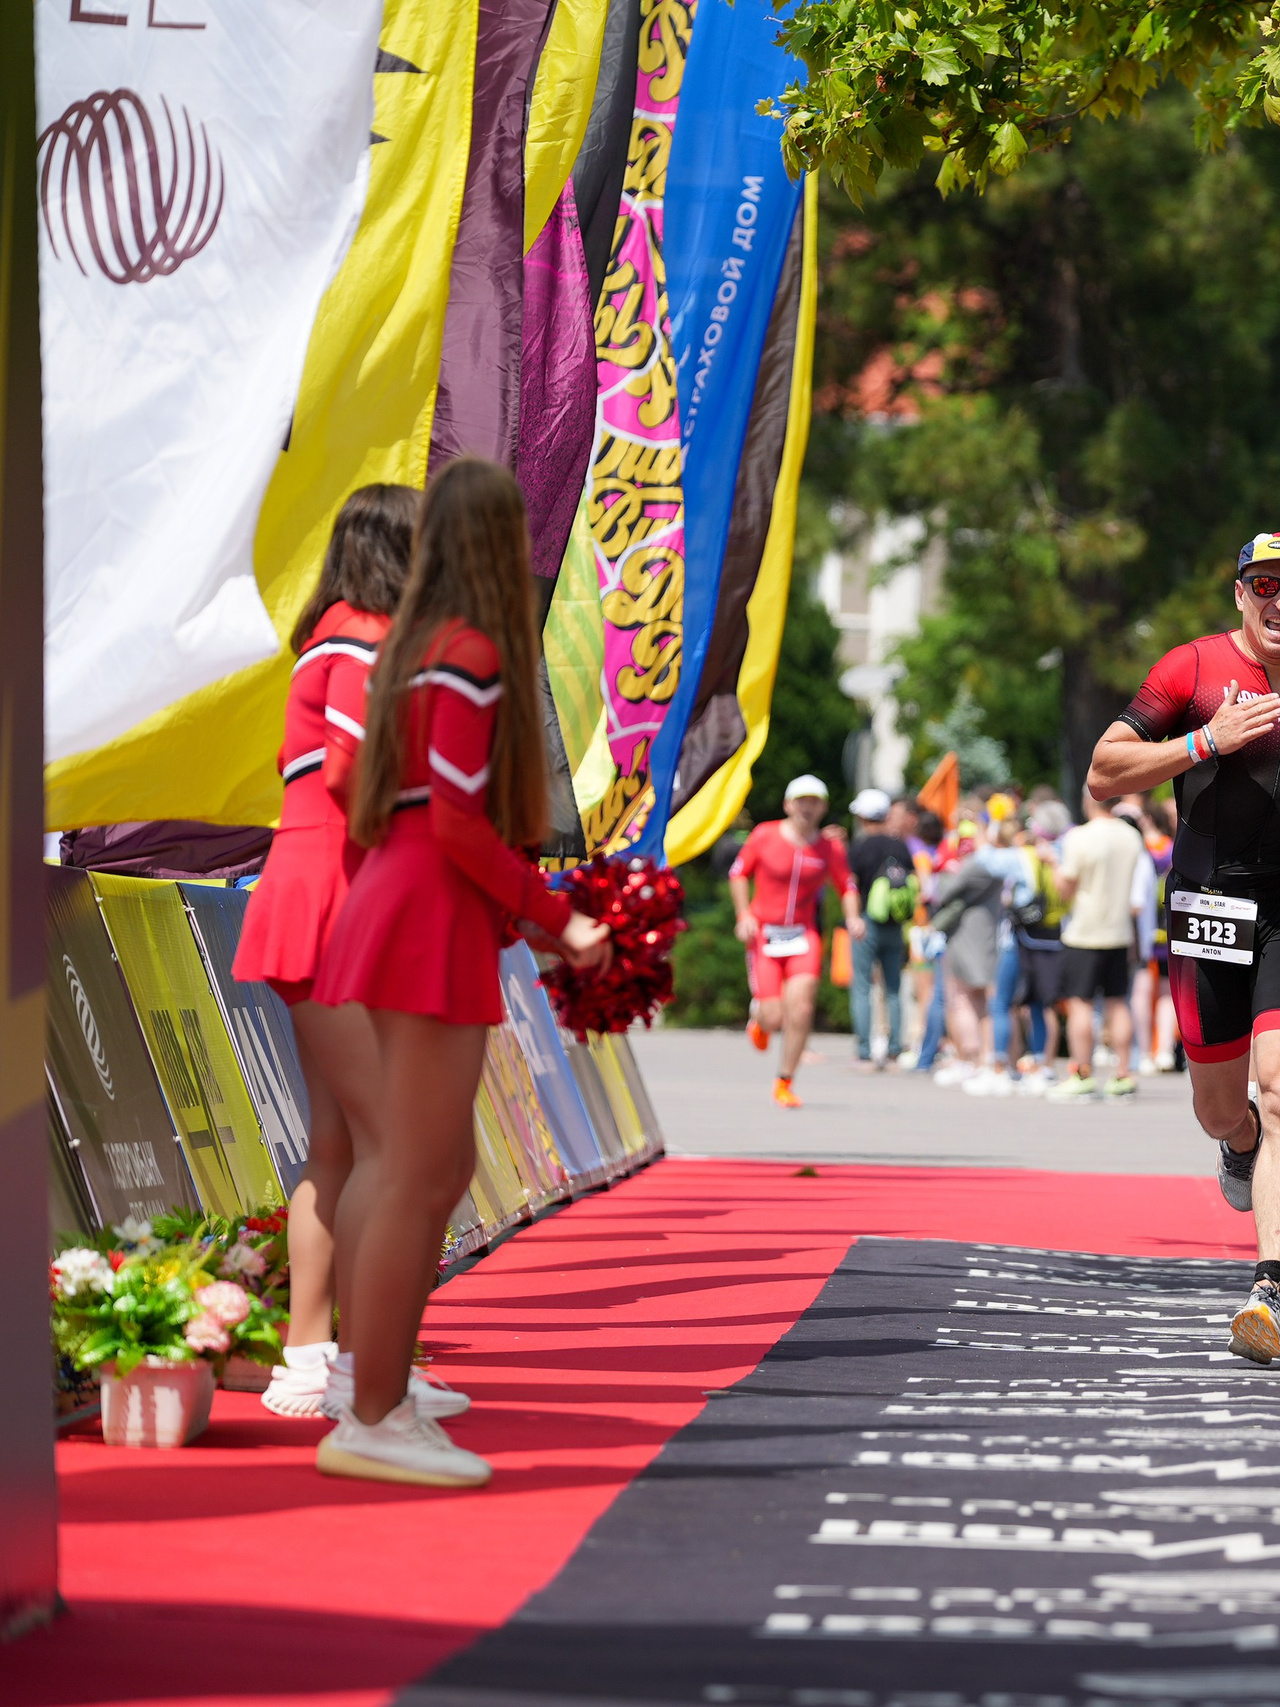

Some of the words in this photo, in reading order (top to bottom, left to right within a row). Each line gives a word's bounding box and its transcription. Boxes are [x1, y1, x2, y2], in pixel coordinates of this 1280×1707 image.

[732, 174, 765, 252] ДОМ
[1199, 898, 1210, 906] IRON
[1214, 900, 1226, 908] STAR
[1187, 917, 1236, 945] 3123
[1202, 948, 1222, 956] ANTON
